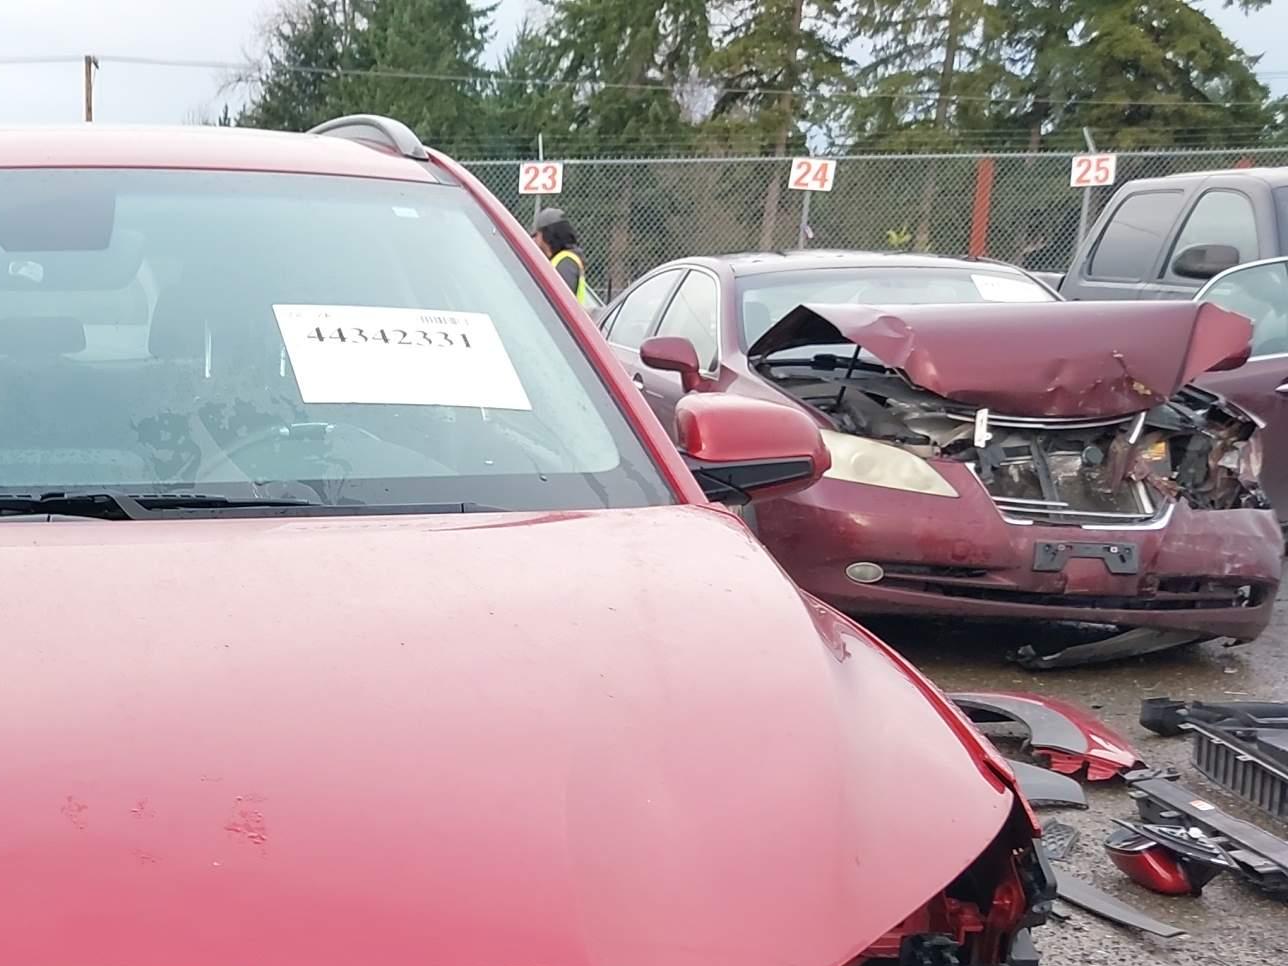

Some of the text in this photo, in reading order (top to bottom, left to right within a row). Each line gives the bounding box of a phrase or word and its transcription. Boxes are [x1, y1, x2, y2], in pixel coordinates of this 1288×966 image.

[524, 165, 558, 191] 23
[793, 161, 828, 189] 24
[1075, 157, 1110, 184] 25
[307, 327, 471, 348] 44342331
